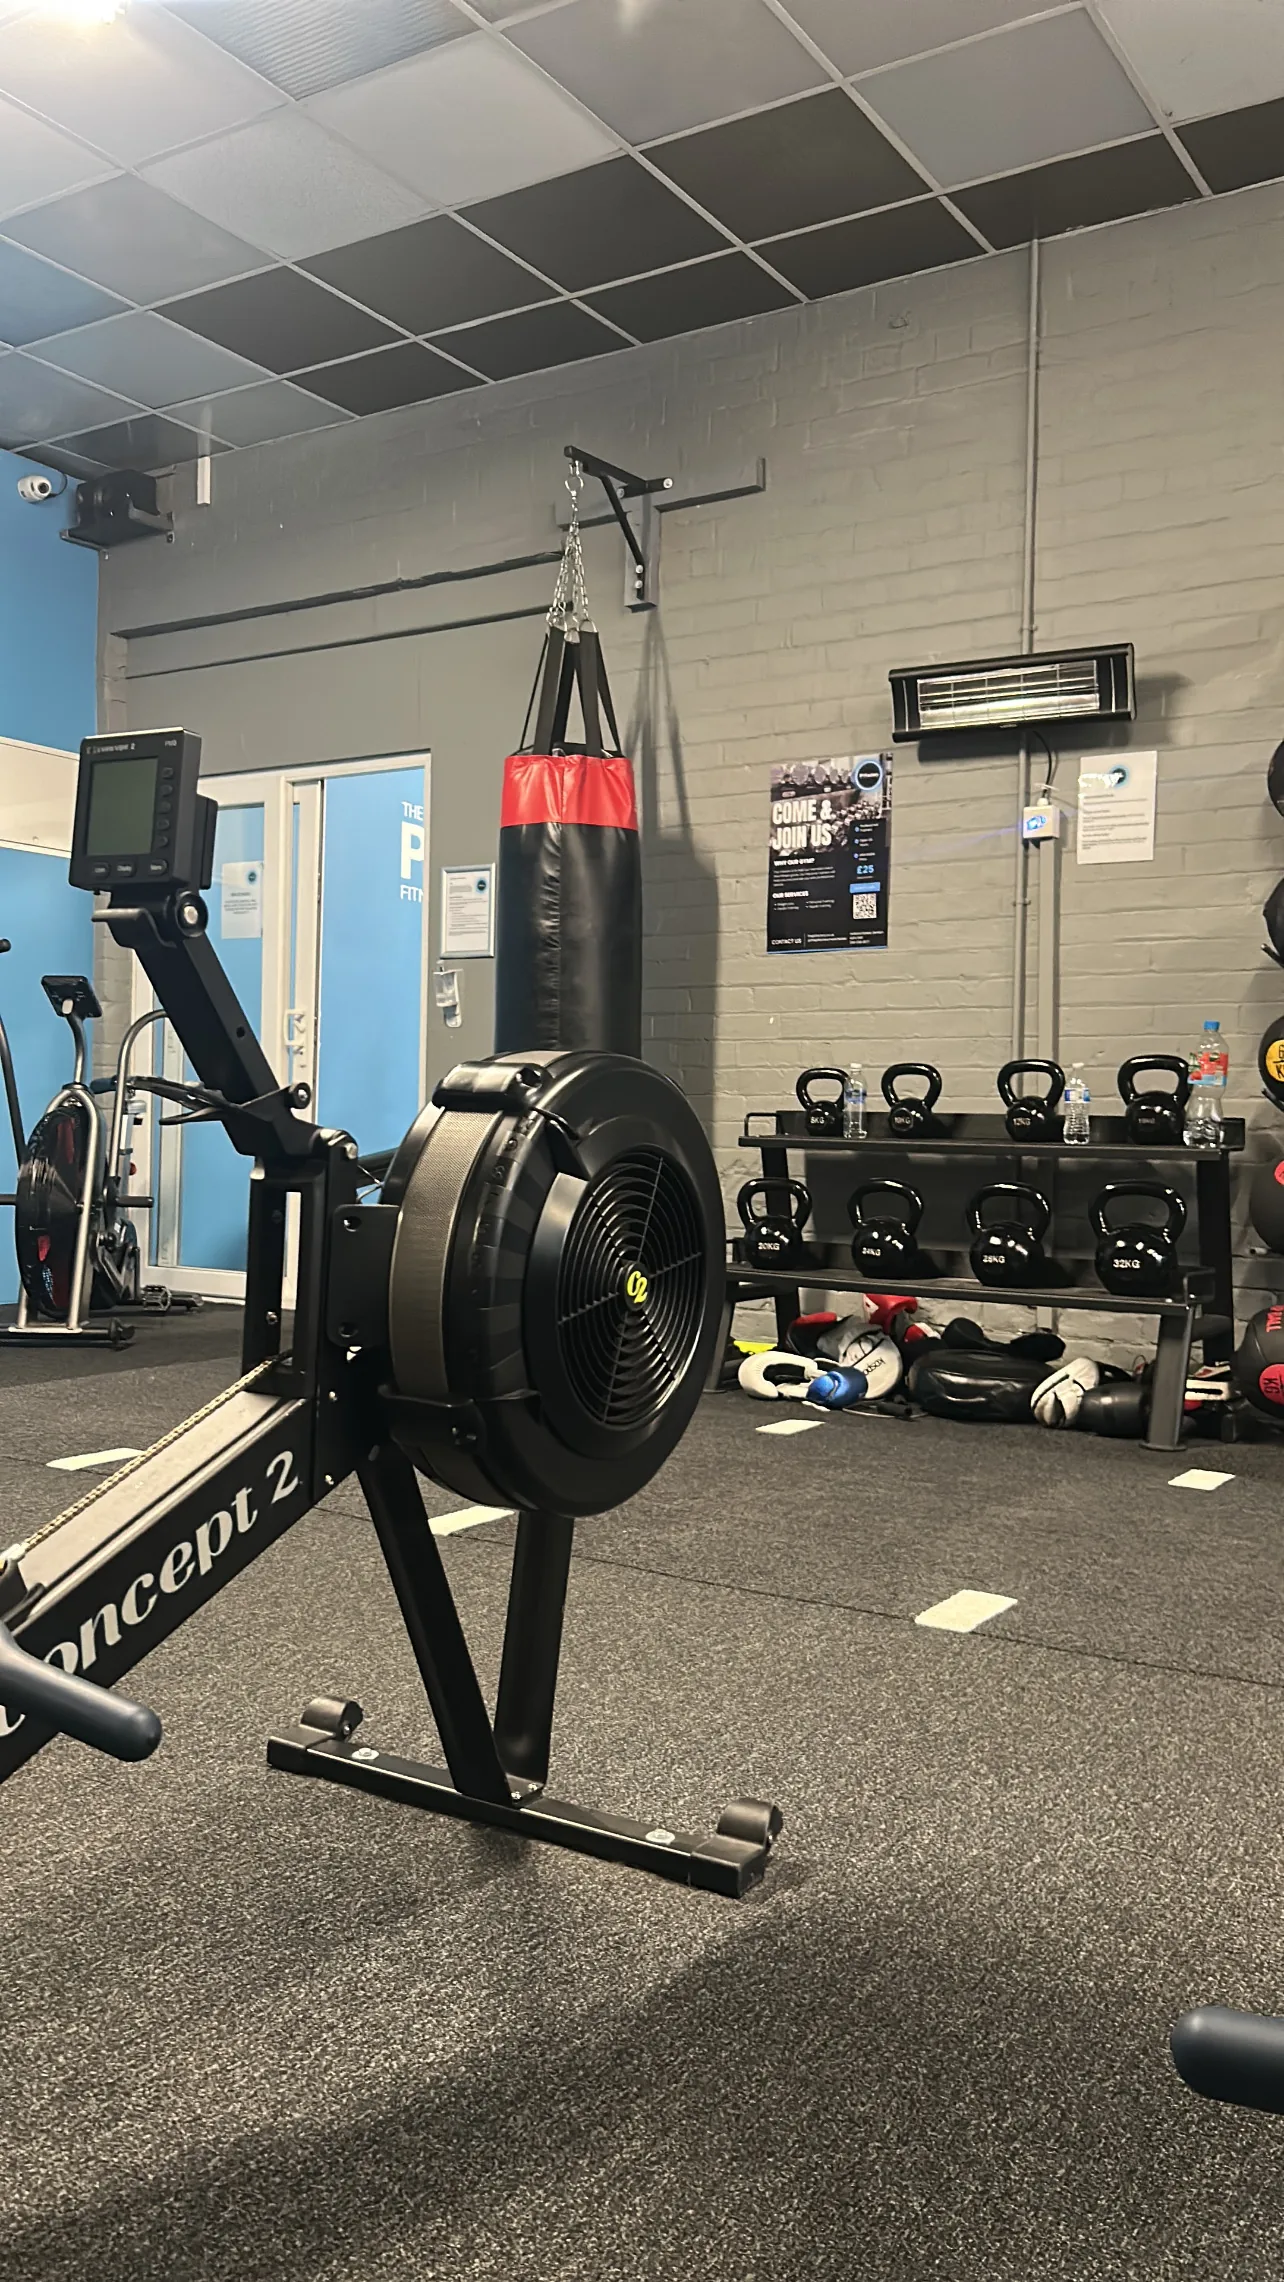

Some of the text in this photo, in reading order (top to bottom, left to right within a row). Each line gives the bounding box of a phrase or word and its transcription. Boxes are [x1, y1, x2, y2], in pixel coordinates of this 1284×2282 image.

[401, 801, 424, 821] THE
[772, 799, 833, 825] COME &
[772, 825, 808, 850] JOIN
[810, 823, 832, 847] US
[856, 864, 875, 875] £25
[757, 1242, 780, 1251] 20KG
[982, 1254, 1005, 1264] 28KG
[1112, 1258, 1141, 1269] 32KG
[1263, 1378, 1280, 1394] KG
[0, 1450, 300, 1737] oncept 2
